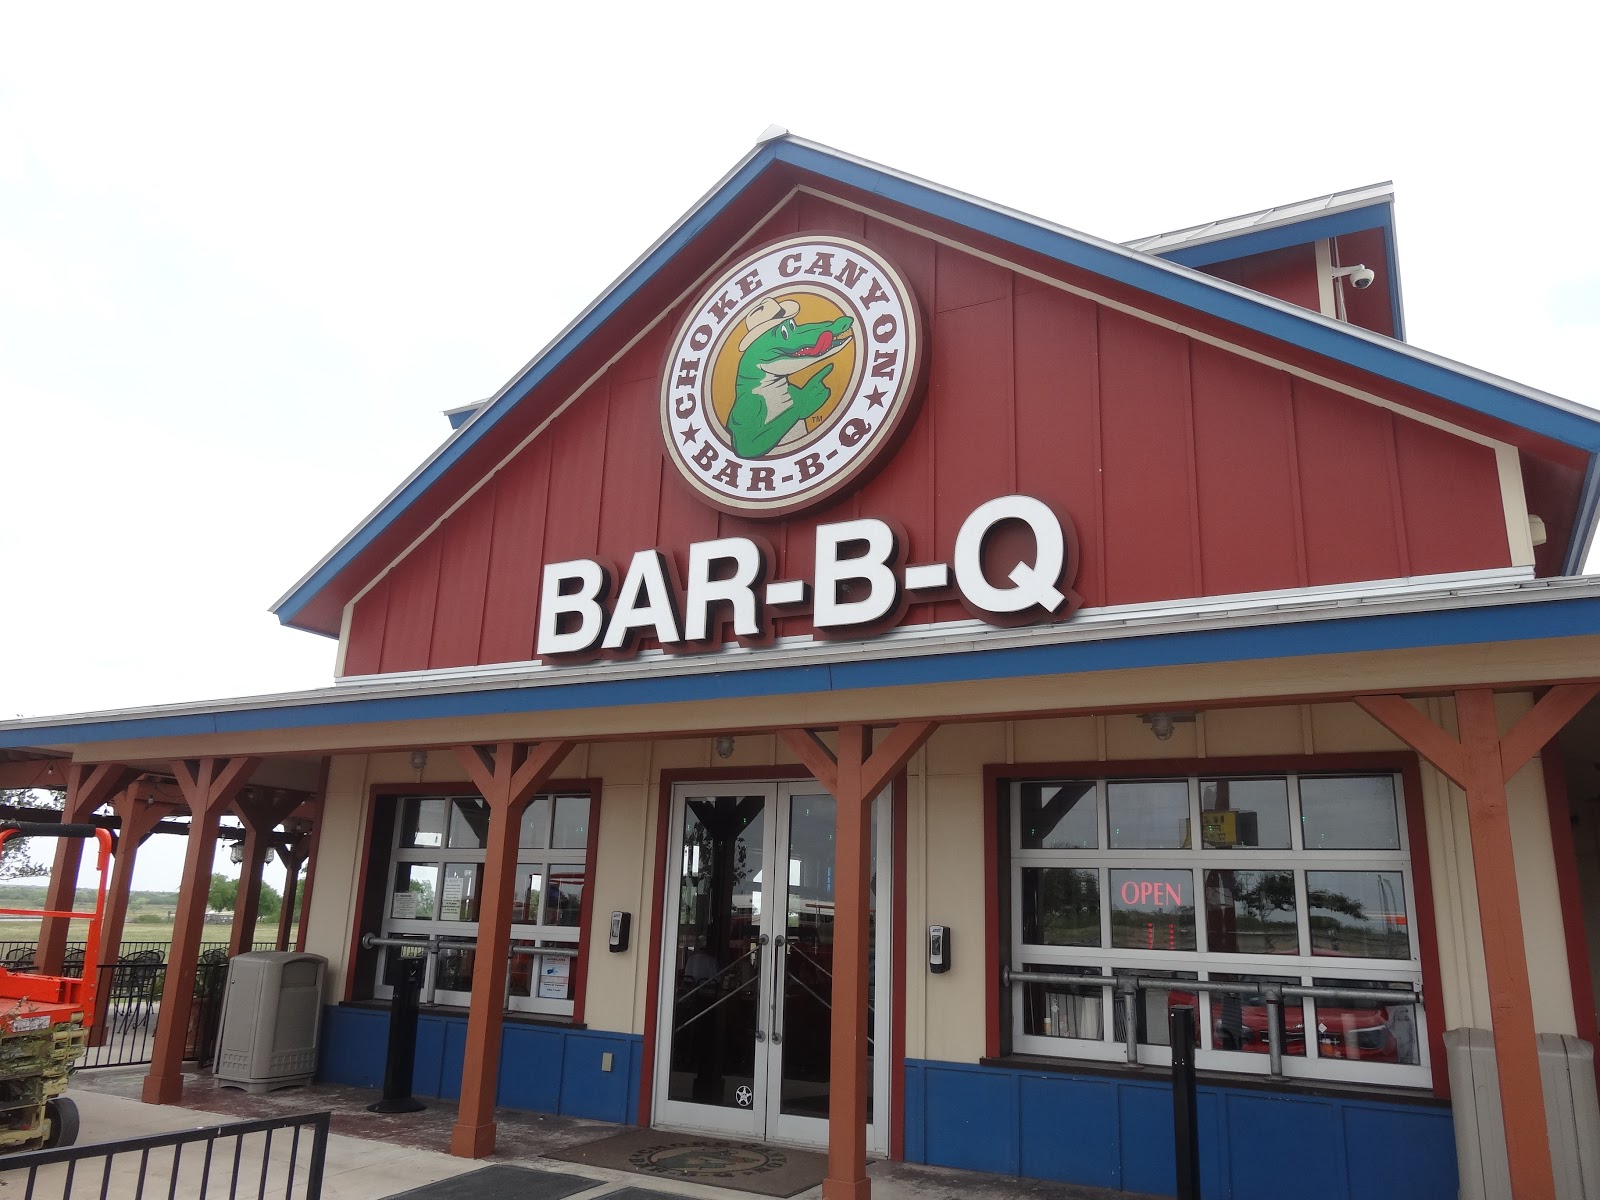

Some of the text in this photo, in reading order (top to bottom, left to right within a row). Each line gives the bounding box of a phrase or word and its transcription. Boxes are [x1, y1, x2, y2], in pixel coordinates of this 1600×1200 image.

[675, 251, 898, 420] CHOKE CANYON
[691, 417, 873, 492] BAR-B-Q
[536, 494, 1066, 655] BAR-B-Q
[1120, 880, 1182, 907] OPEN
